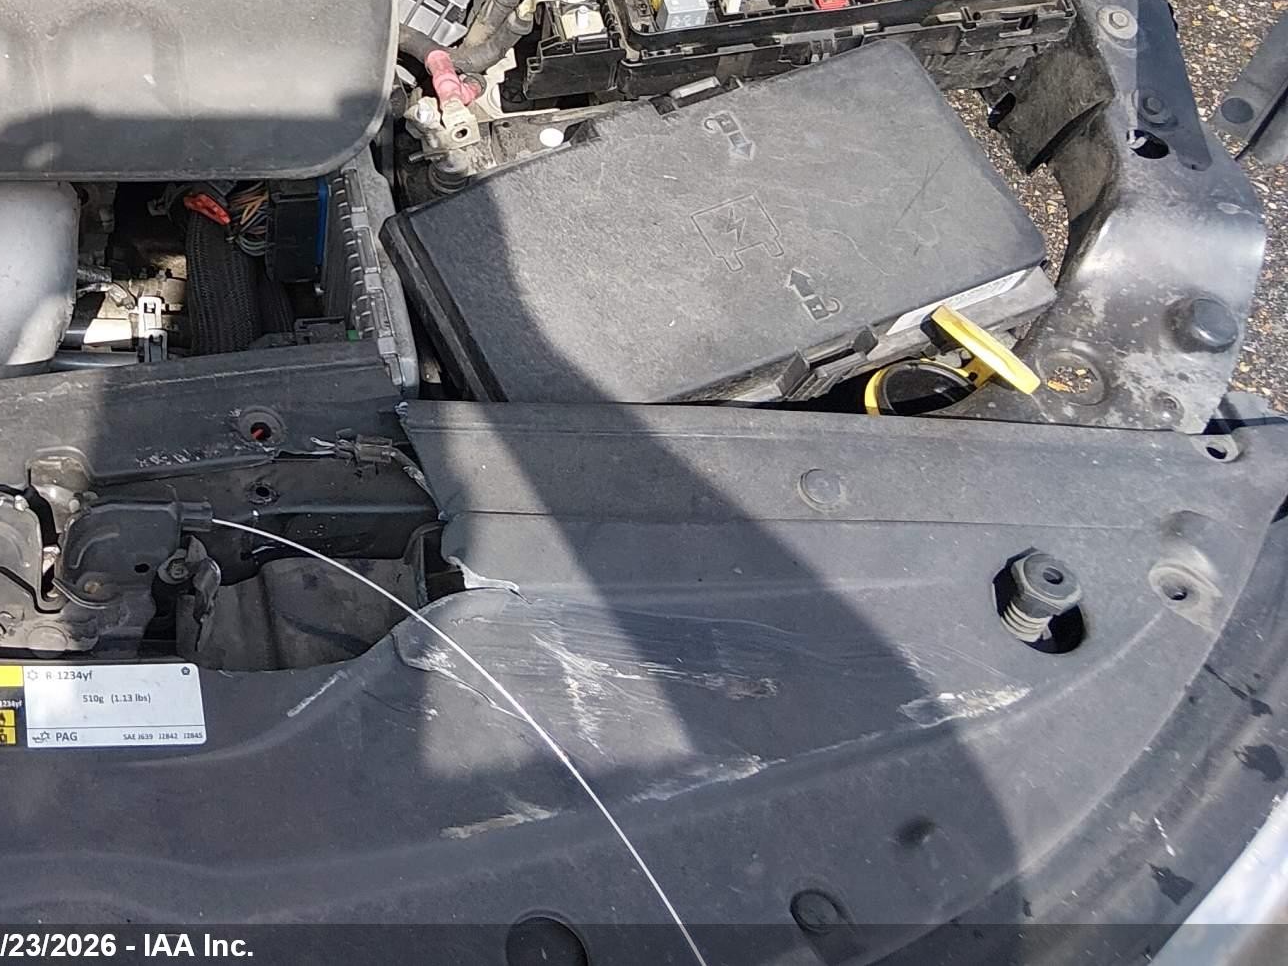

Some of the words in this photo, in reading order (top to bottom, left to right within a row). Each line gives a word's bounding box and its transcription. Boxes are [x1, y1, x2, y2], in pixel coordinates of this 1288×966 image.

[83, 694, 104, 704] 510g
[111, 693, 133, 704] (1.13
[135, 693, 151, 704] lbs)
[56, 731, 78, 742] PAG
